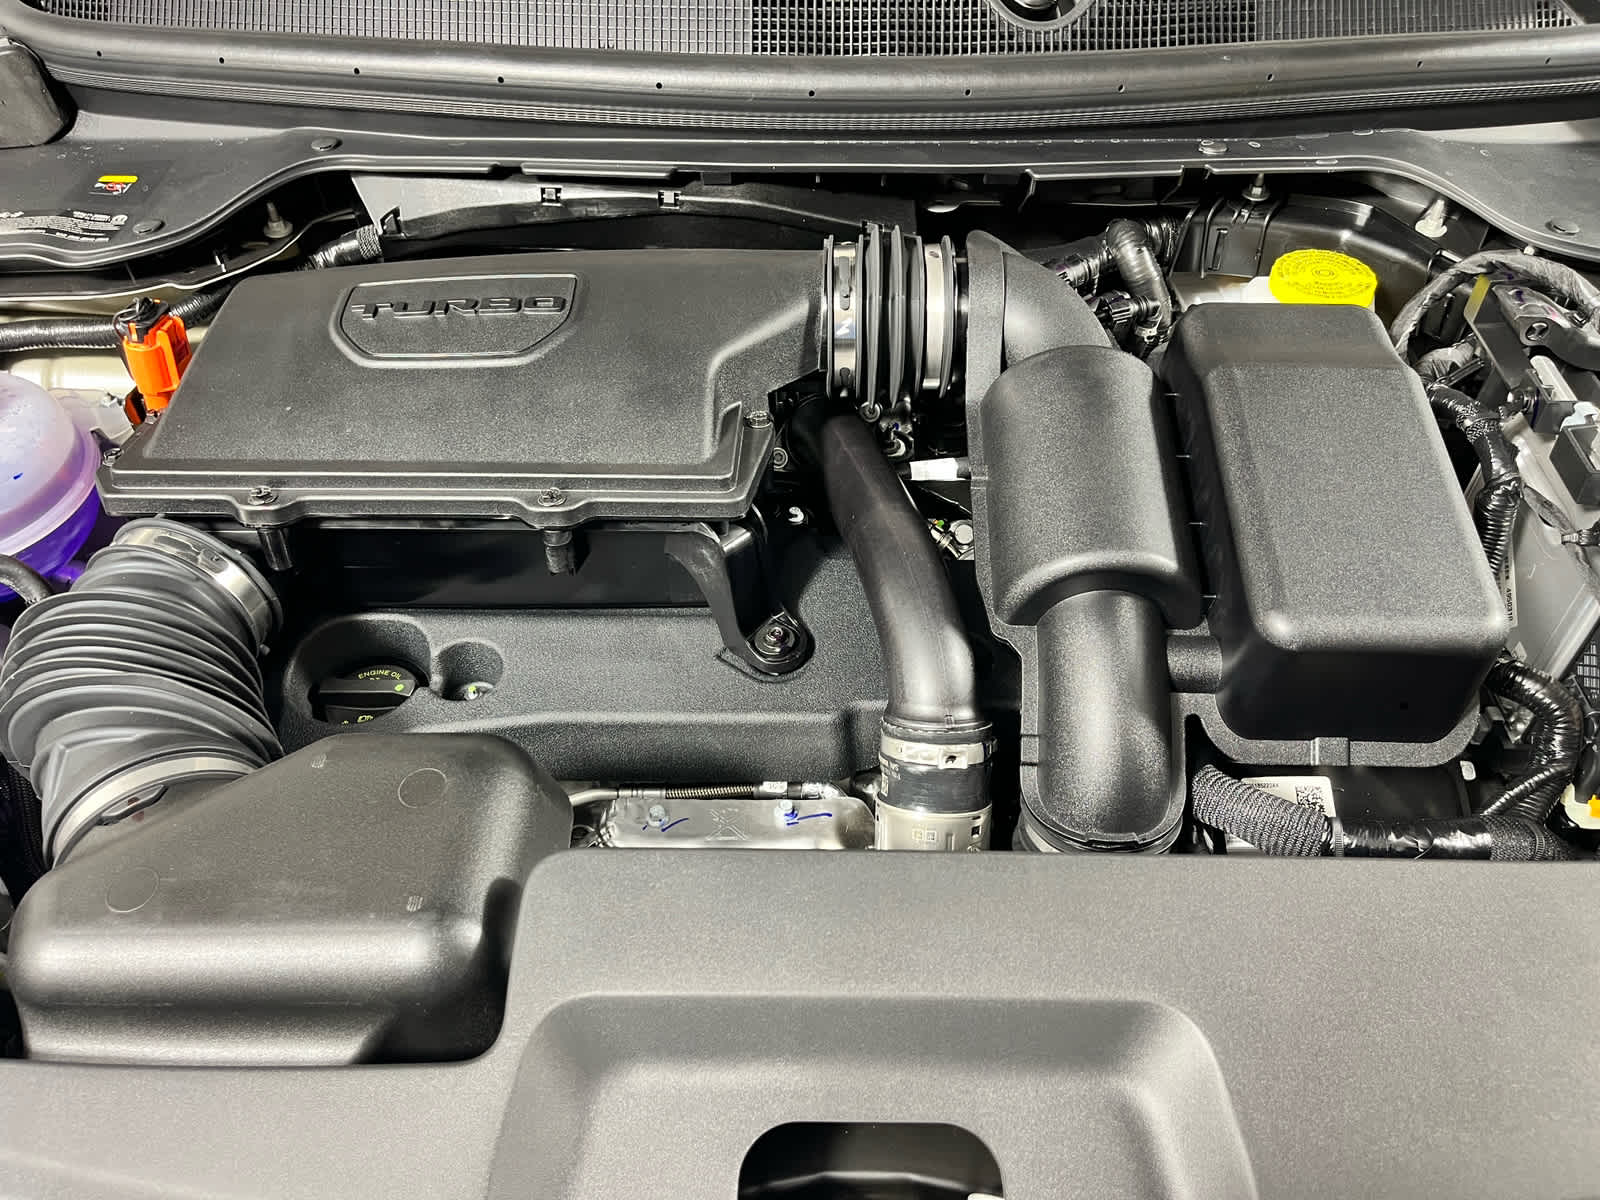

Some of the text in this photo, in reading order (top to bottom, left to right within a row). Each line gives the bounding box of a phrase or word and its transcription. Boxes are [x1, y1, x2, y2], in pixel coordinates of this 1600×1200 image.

[351, 297, 567, 321] TURBO
[358, 669, 402, 680] ENGINE OIL
